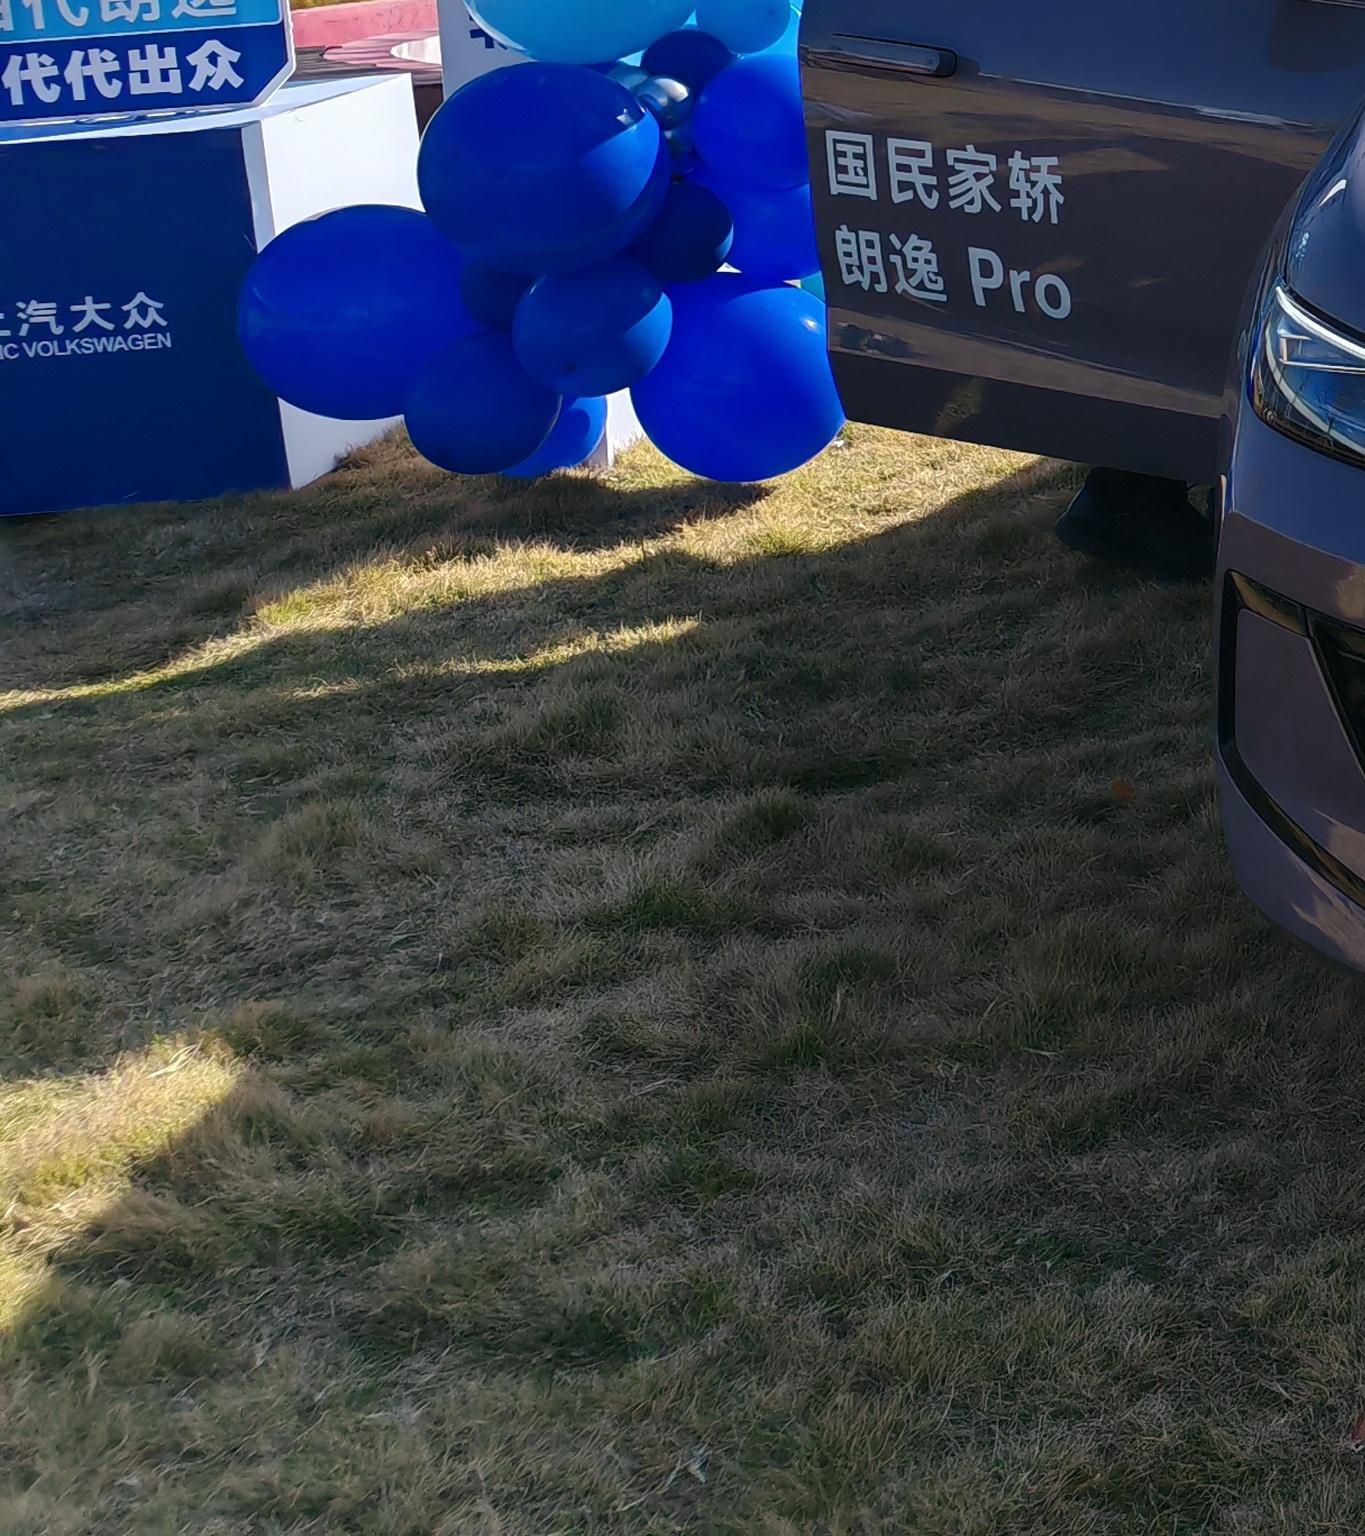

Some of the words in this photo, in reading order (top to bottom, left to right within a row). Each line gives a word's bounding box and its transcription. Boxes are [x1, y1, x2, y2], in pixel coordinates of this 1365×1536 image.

[1, 38, 245, 106] 代代出众
[824, 129, 1065, 225] 国民家轿
[834, 224, 948, 302] 朗逸
[967, 246, 1073, 320] Pro
[22, 332, 172, 358] VOLKSWAGEN
